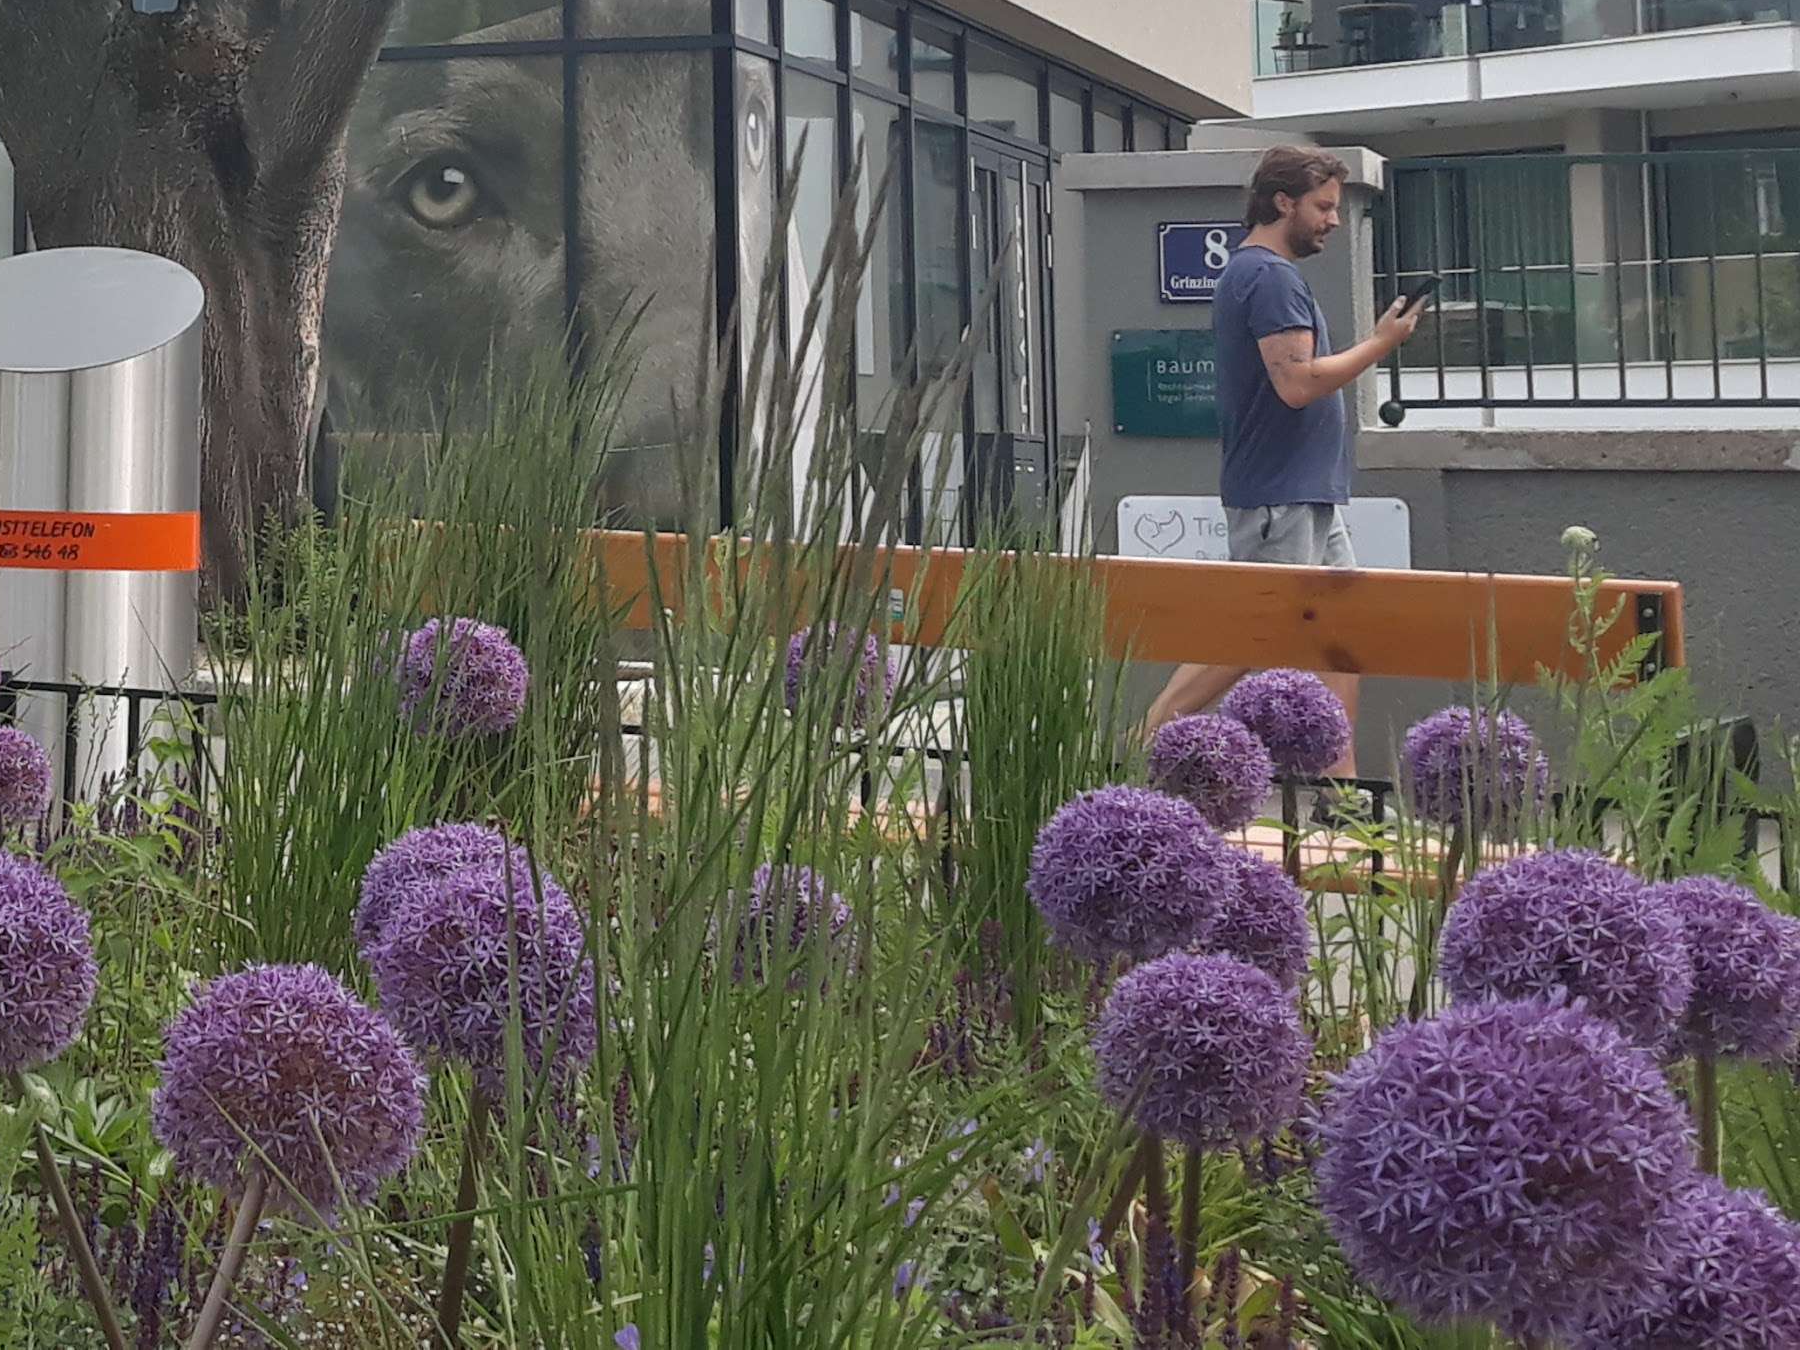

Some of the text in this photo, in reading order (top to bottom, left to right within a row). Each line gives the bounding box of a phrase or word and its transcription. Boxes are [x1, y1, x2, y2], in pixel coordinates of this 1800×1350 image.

[1204, 229, 1230, 269] 8
[1170, 274, 1218, 290] Grinzin
[22, 543, 80, 561] 546 48
